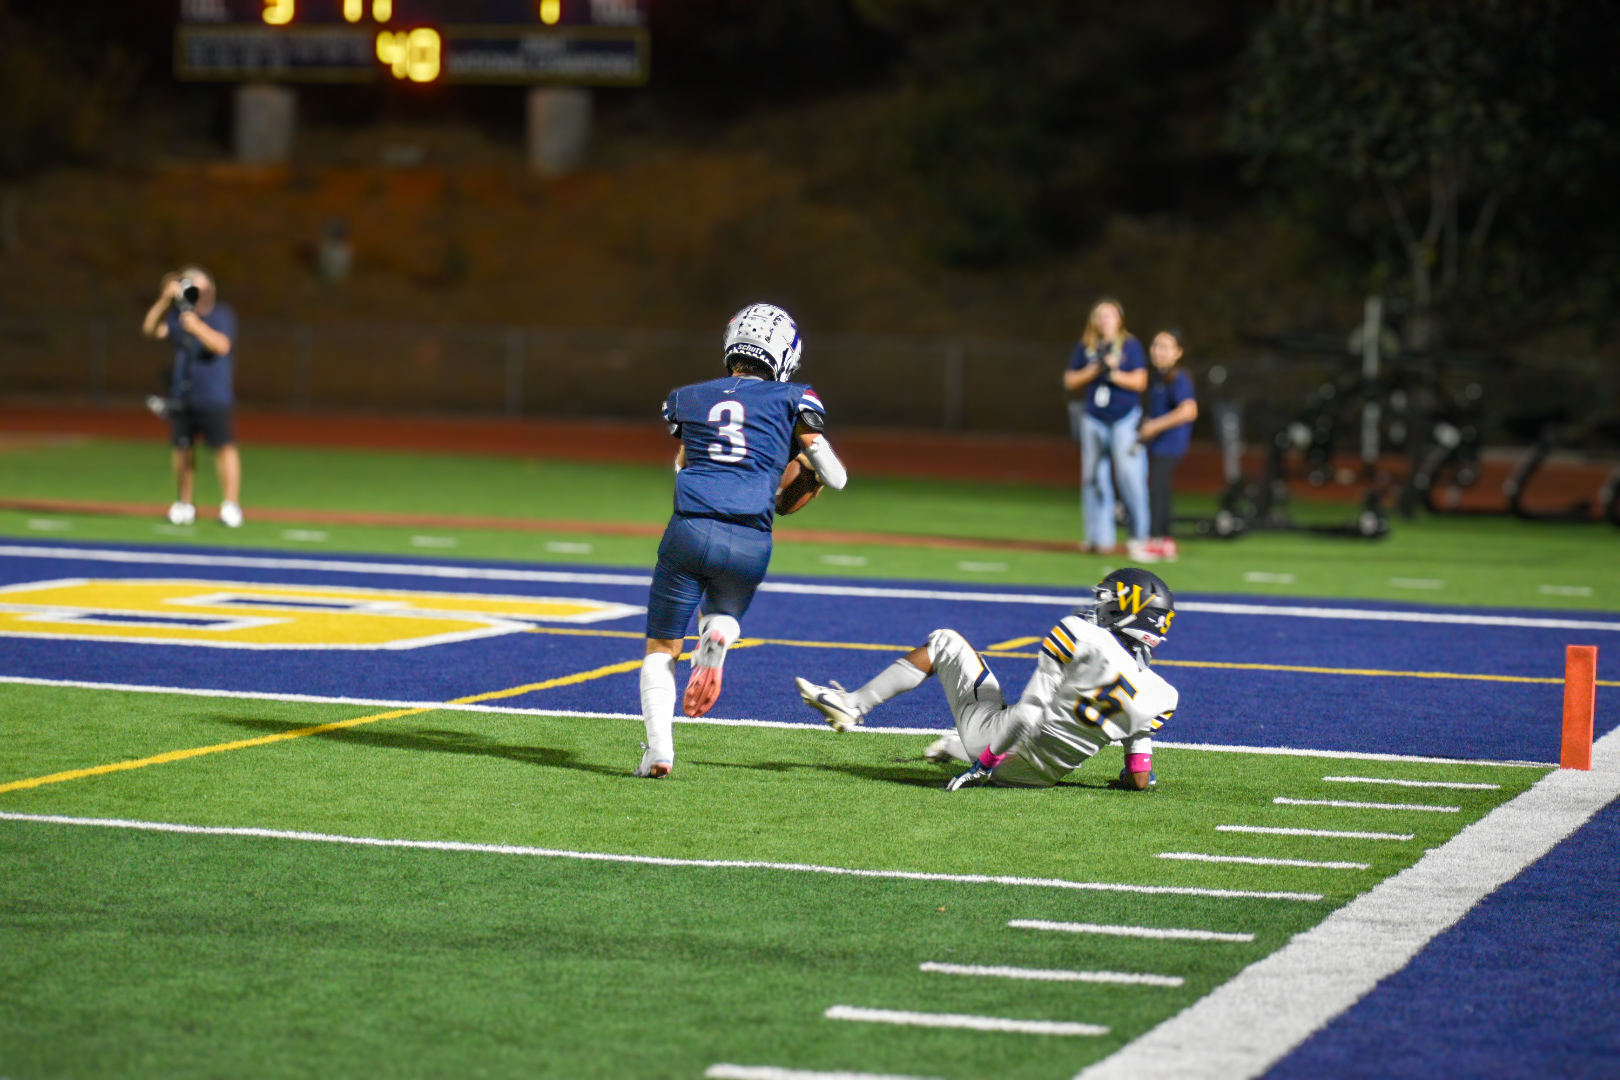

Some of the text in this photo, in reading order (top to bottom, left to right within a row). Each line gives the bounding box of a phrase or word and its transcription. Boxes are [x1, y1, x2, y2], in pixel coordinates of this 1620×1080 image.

[376, 28, 441, 83] 40
[707, 400, 748, 463] 3
[1116, 581, 1157, 615] W
